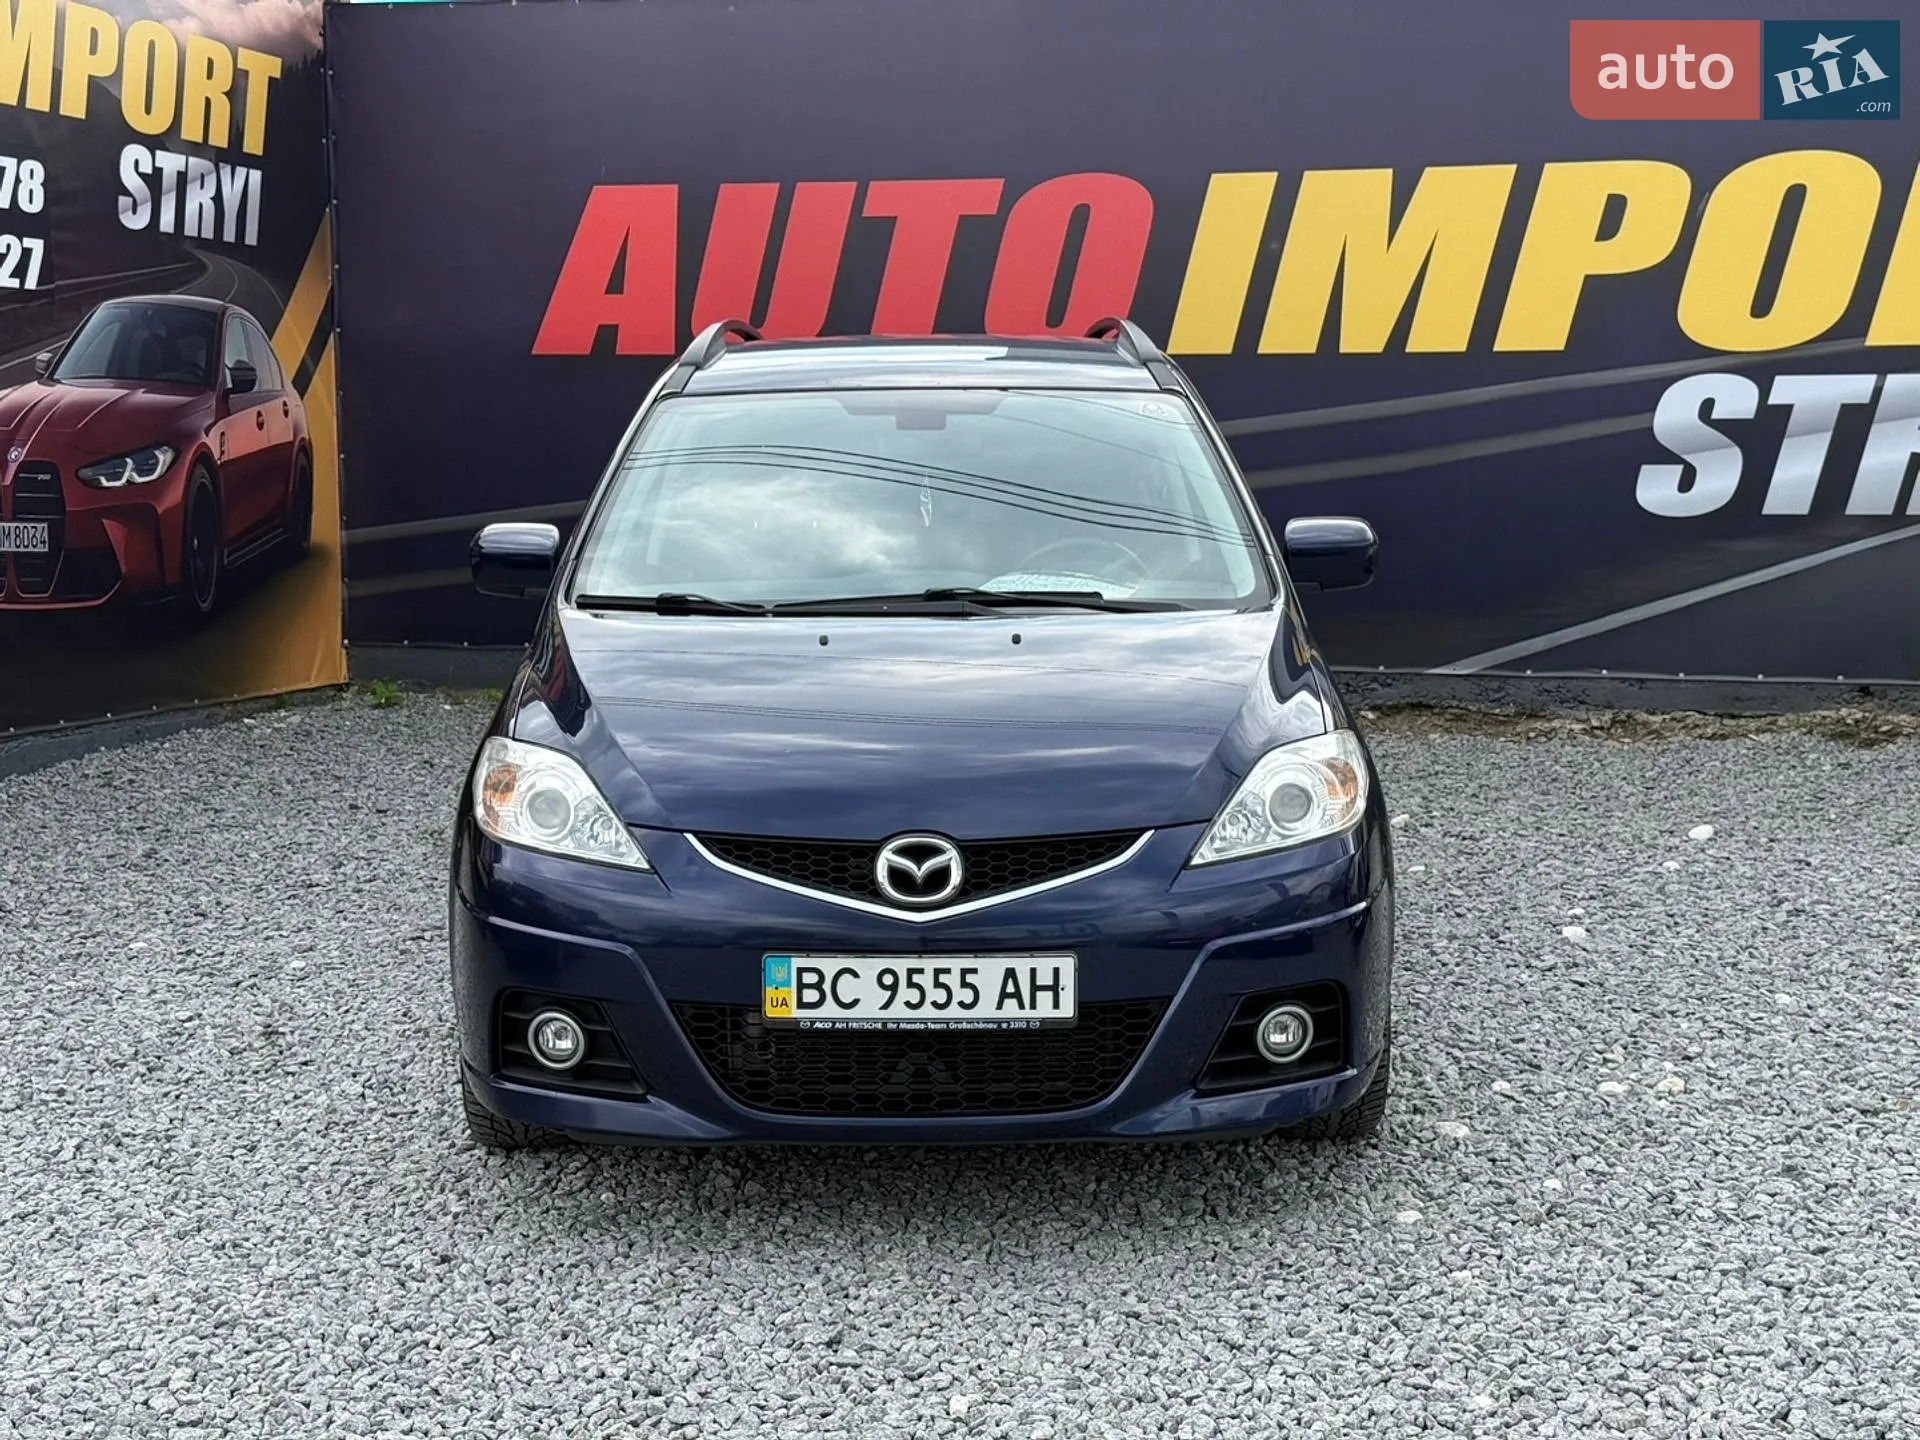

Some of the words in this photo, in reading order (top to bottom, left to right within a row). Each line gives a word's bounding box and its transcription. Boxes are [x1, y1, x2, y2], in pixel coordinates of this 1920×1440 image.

[117, 143, 262, 246] STRYI
[0, 233, 45, 290] 27
[532, 172, 1154, 355] AUTO
[770, 998, 789, 1009] UA
[796, 967, 861, 1010] BC
[877, 967, 980, 1010] 9555
[995, 967, 1061, 1010] AH
